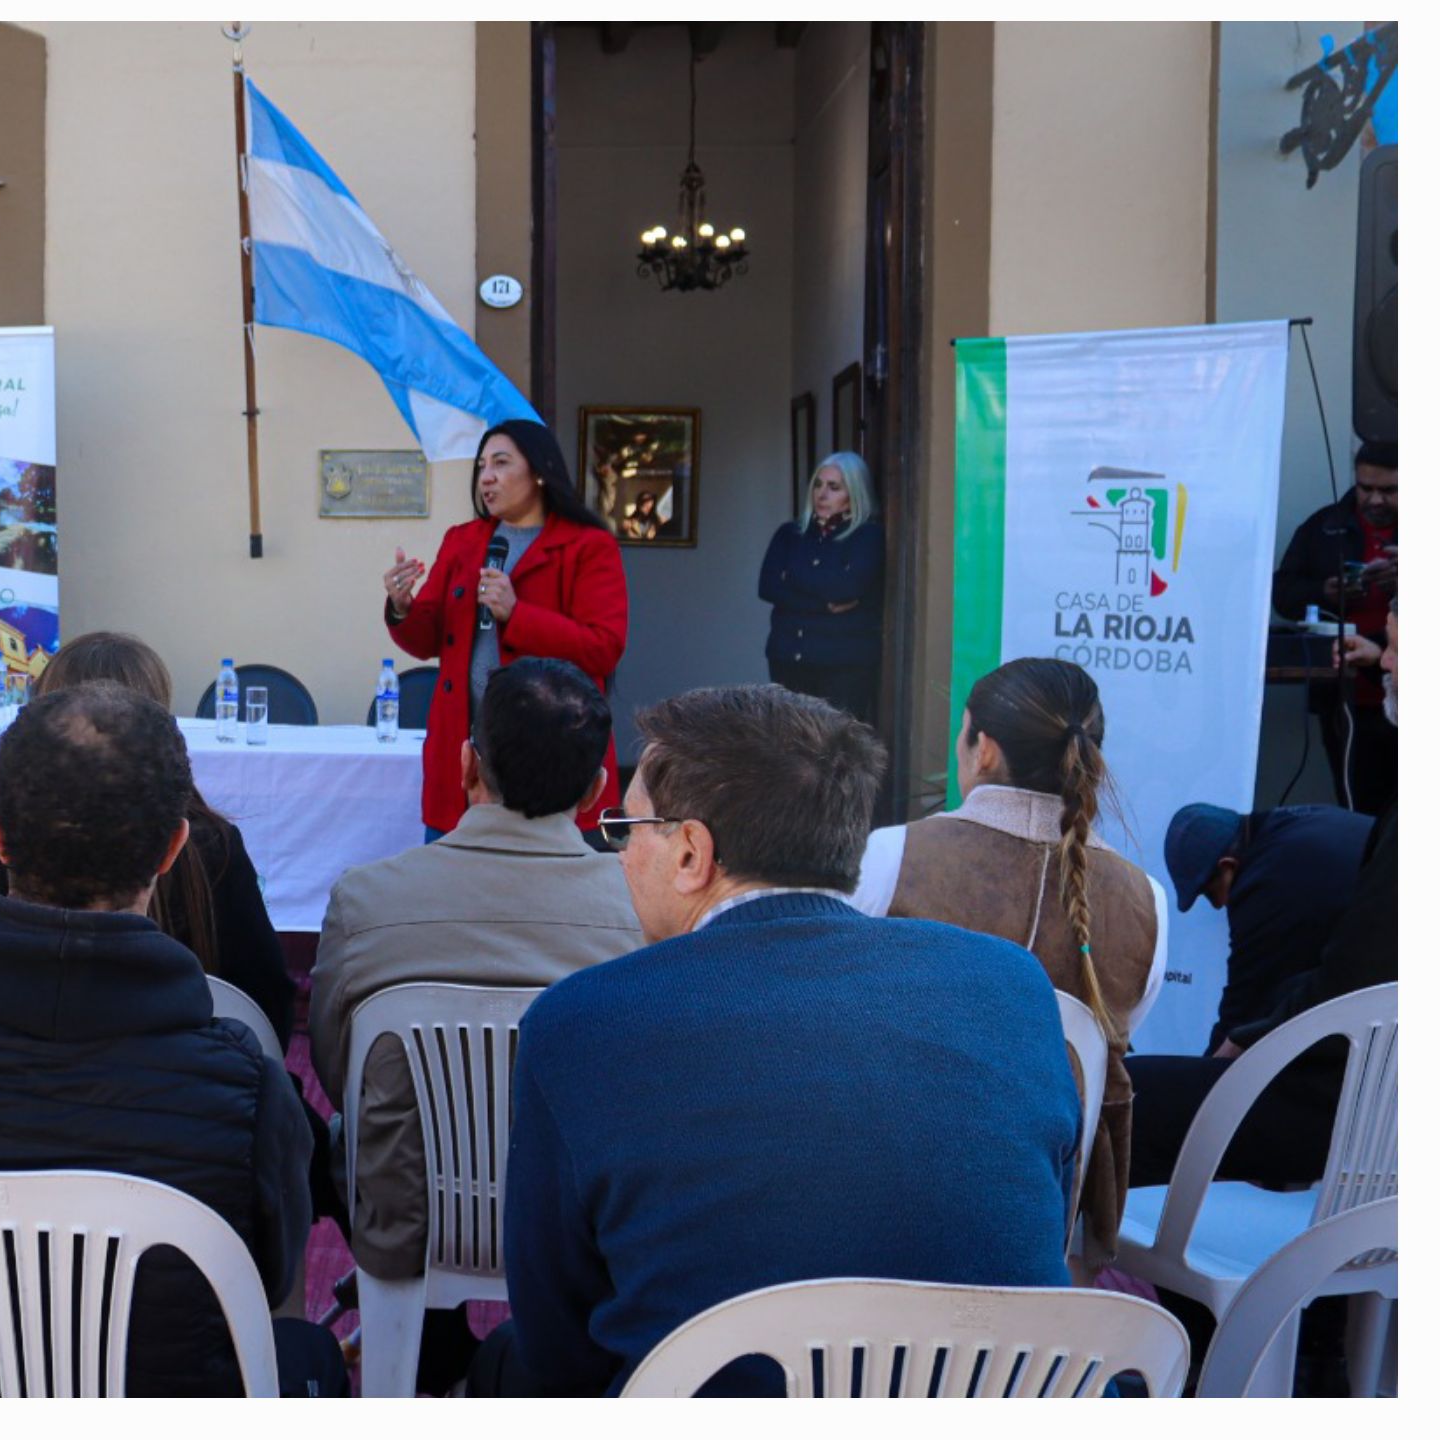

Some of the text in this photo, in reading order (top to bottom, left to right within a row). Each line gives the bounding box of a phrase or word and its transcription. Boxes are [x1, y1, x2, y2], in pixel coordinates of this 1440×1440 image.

[1054, 591, 1145, 613] CASA DE
[1054, 611, 1196, 644] LA RIOJA
[1163, 968, 1193, 986] pital
